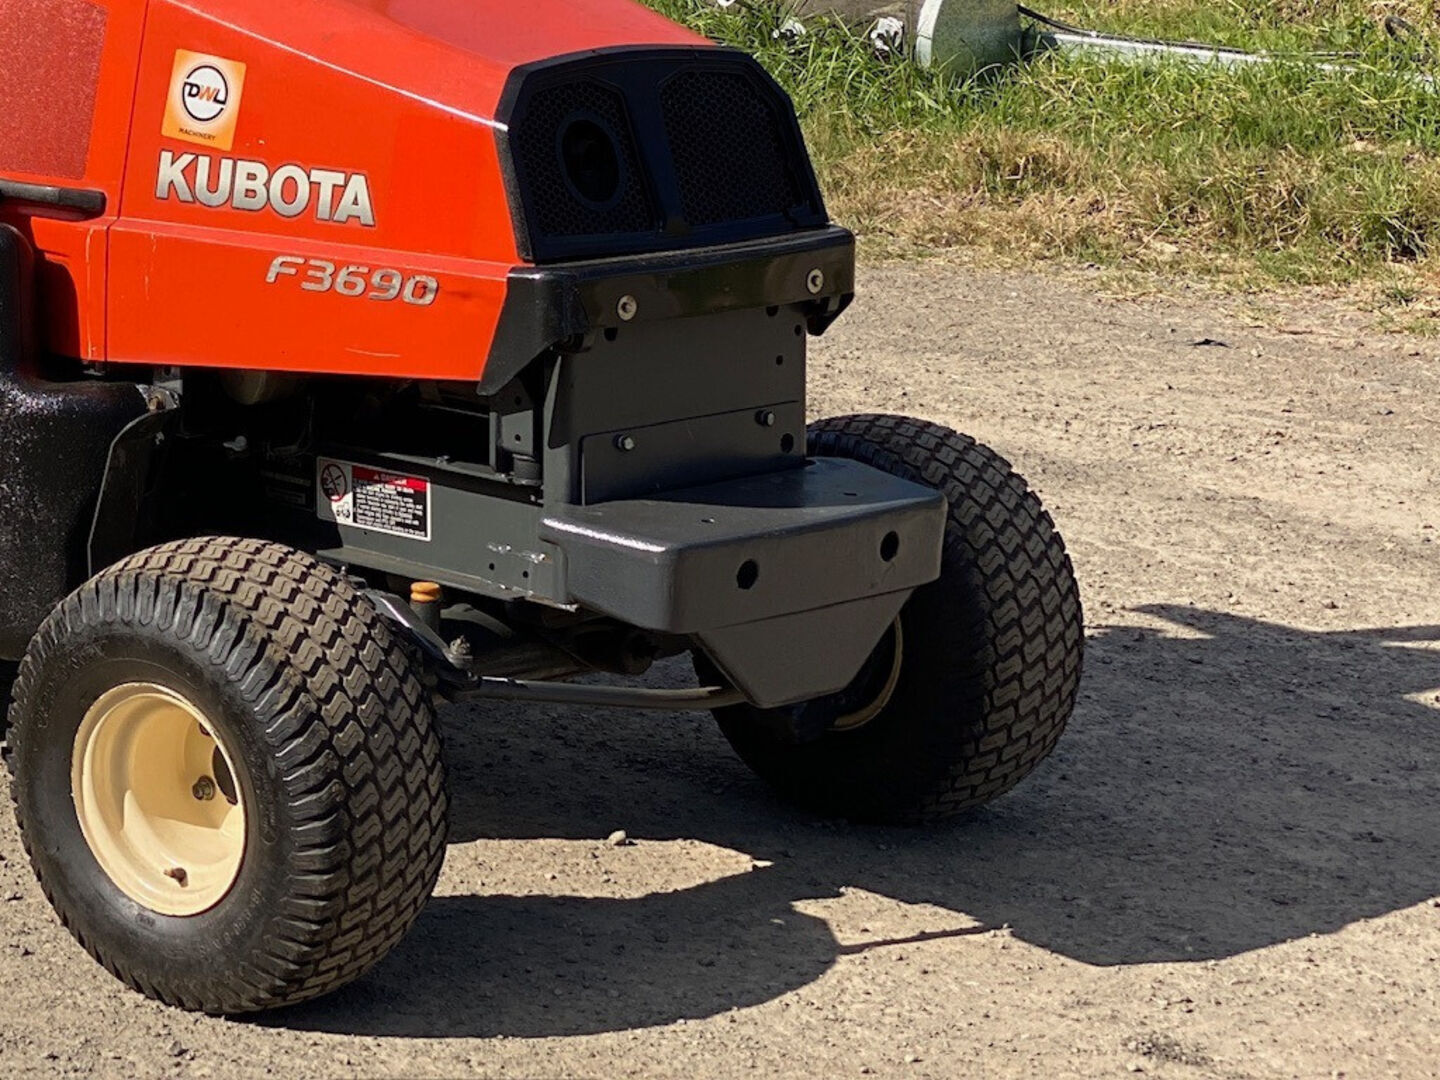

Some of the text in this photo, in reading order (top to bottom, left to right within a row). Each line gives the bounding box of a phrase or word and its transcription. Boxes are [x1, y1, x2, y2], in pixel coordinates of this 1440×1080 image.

[183, 81, 227, 105] DWL
[179, 127, 216, 141] MACHINERY
[155, 150, 375, 227] KUBOTA
[266, 255, 439, 306] F3690
